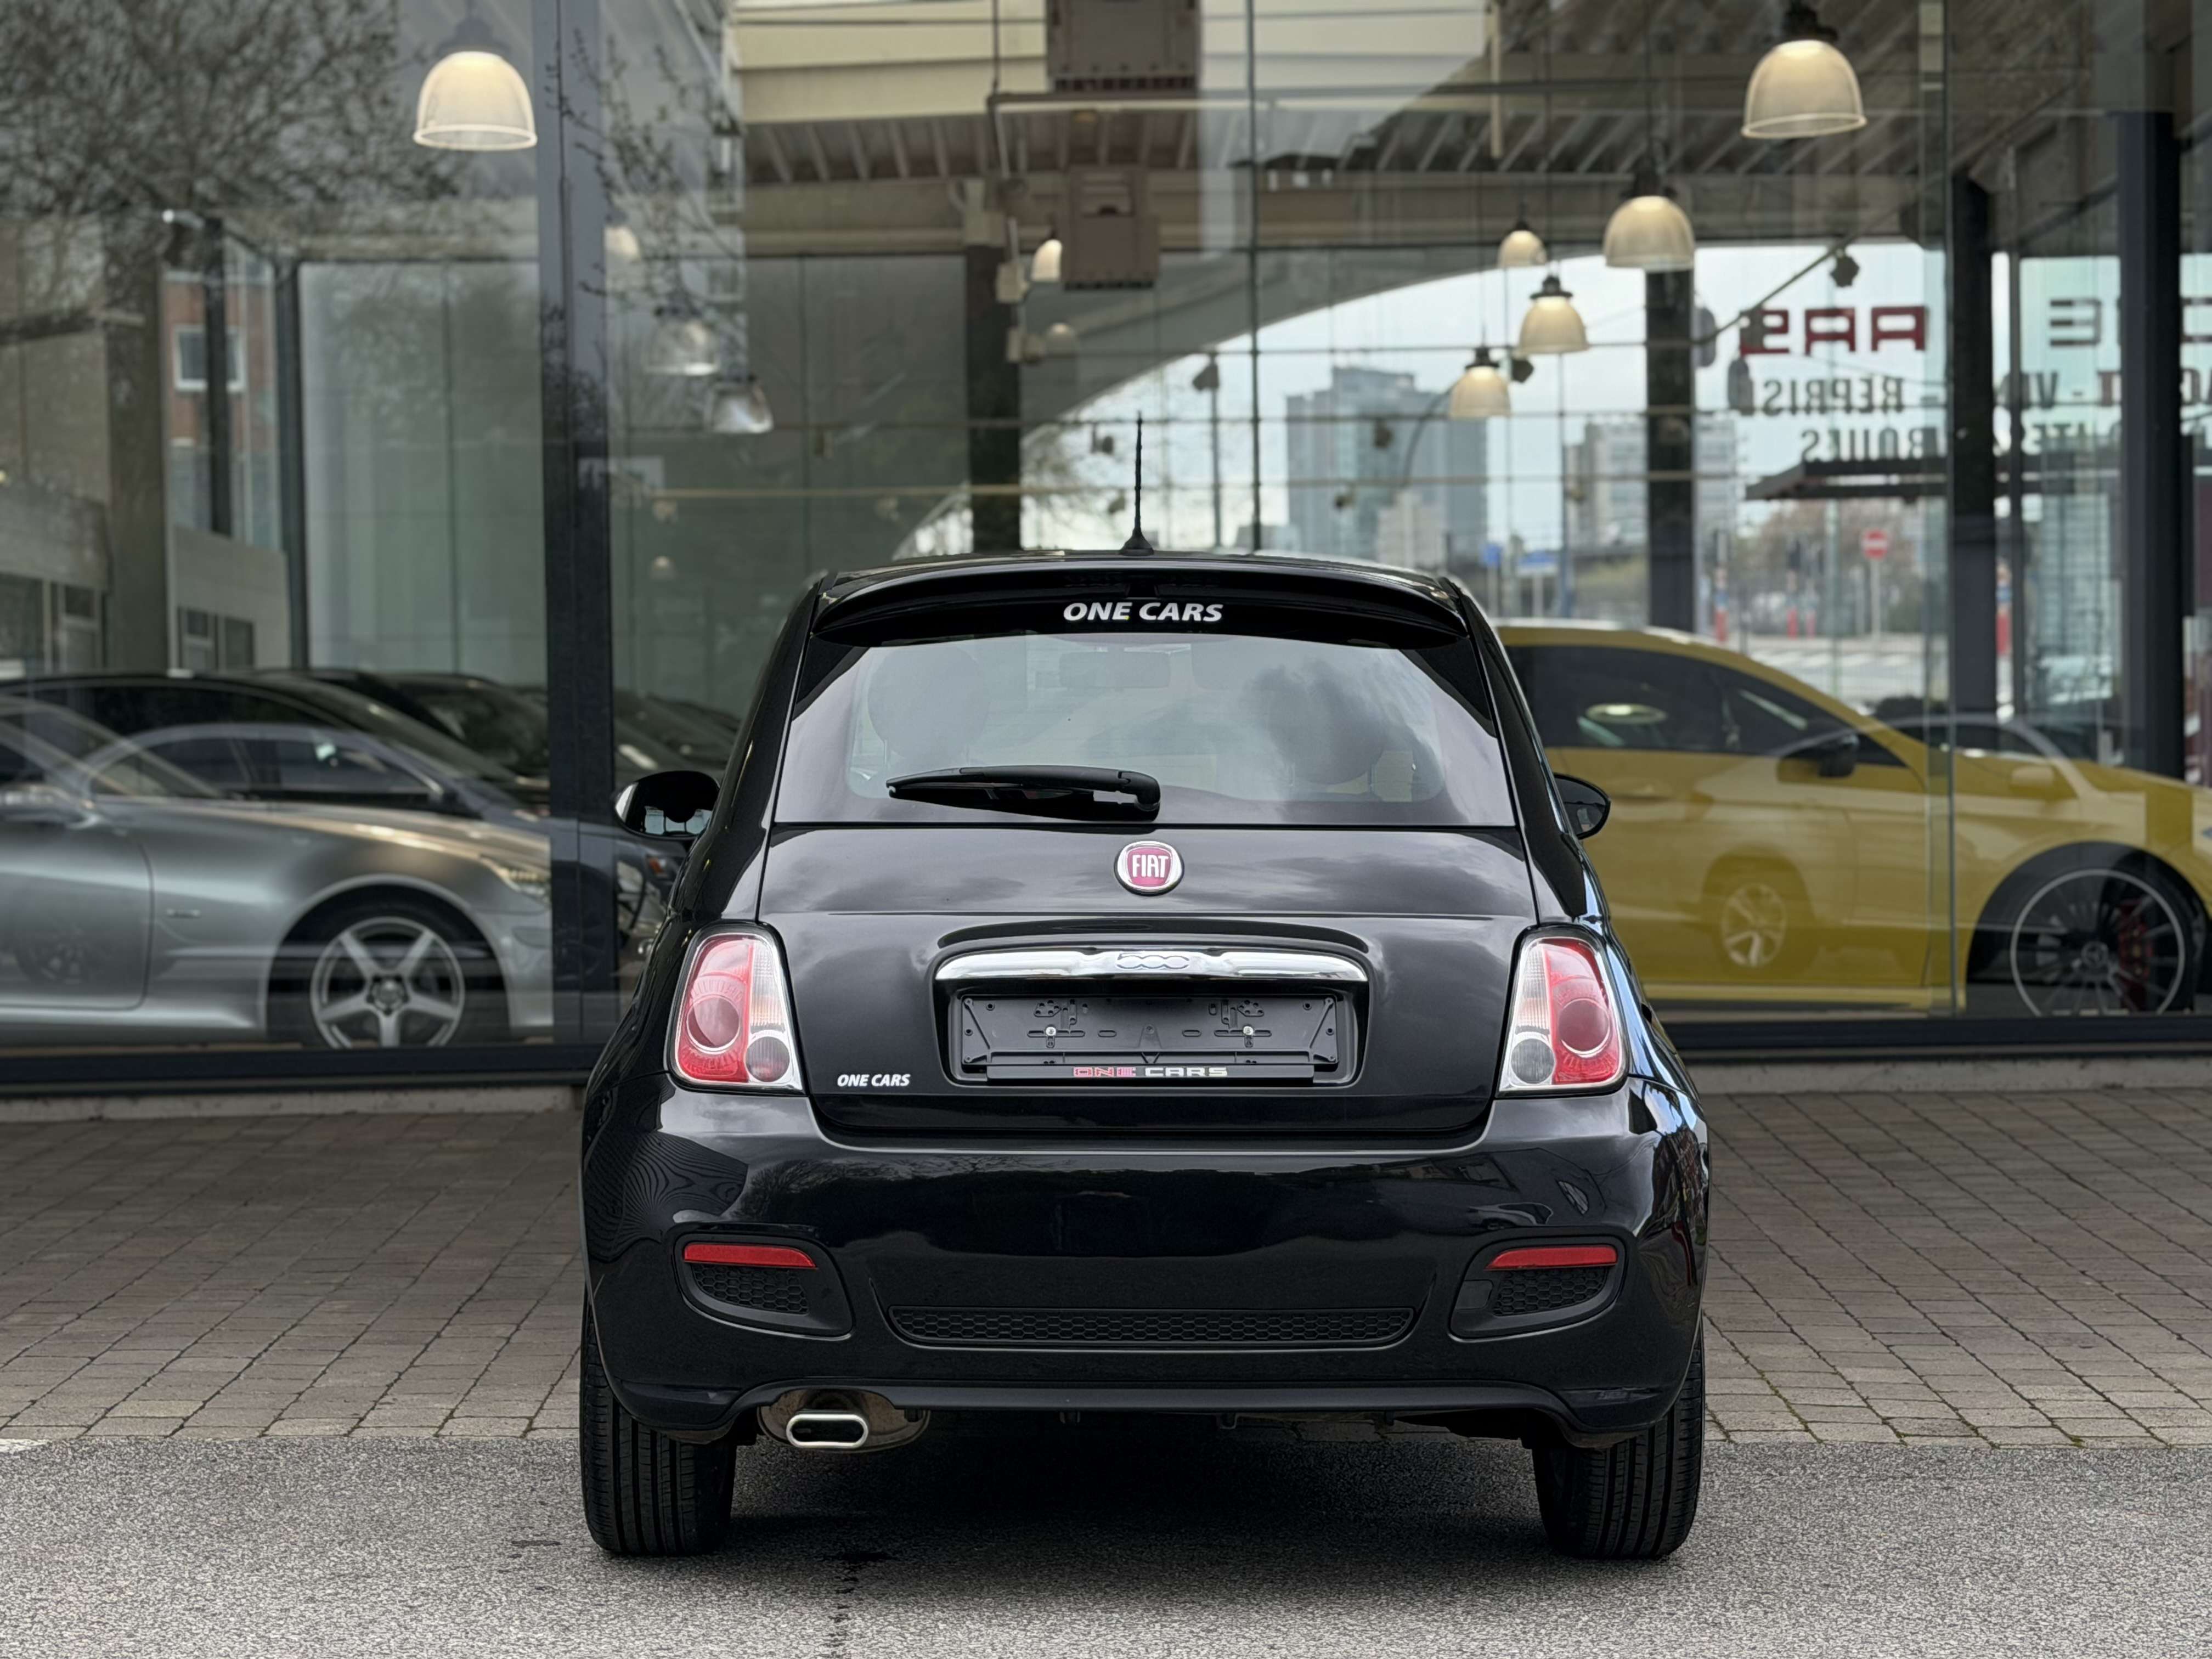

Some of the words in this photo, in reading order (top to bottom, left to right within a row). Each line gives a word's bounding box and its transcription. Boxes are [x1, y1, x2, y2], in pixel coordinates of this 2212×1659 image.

[1063, 602, 1132, 621] ONE
[1139, 603, 1223, 622] CARS
[1132, 854, 1169, 878] FIAT
[1116, 951, 1190, 970] 500
[837, 1074, 870, 1087] ONE
[871, 1074, 911, 1087] CARS
[1073, 1066, 1137, 1077] ONE
[1144, 1067, 1228, 1077] CARS
